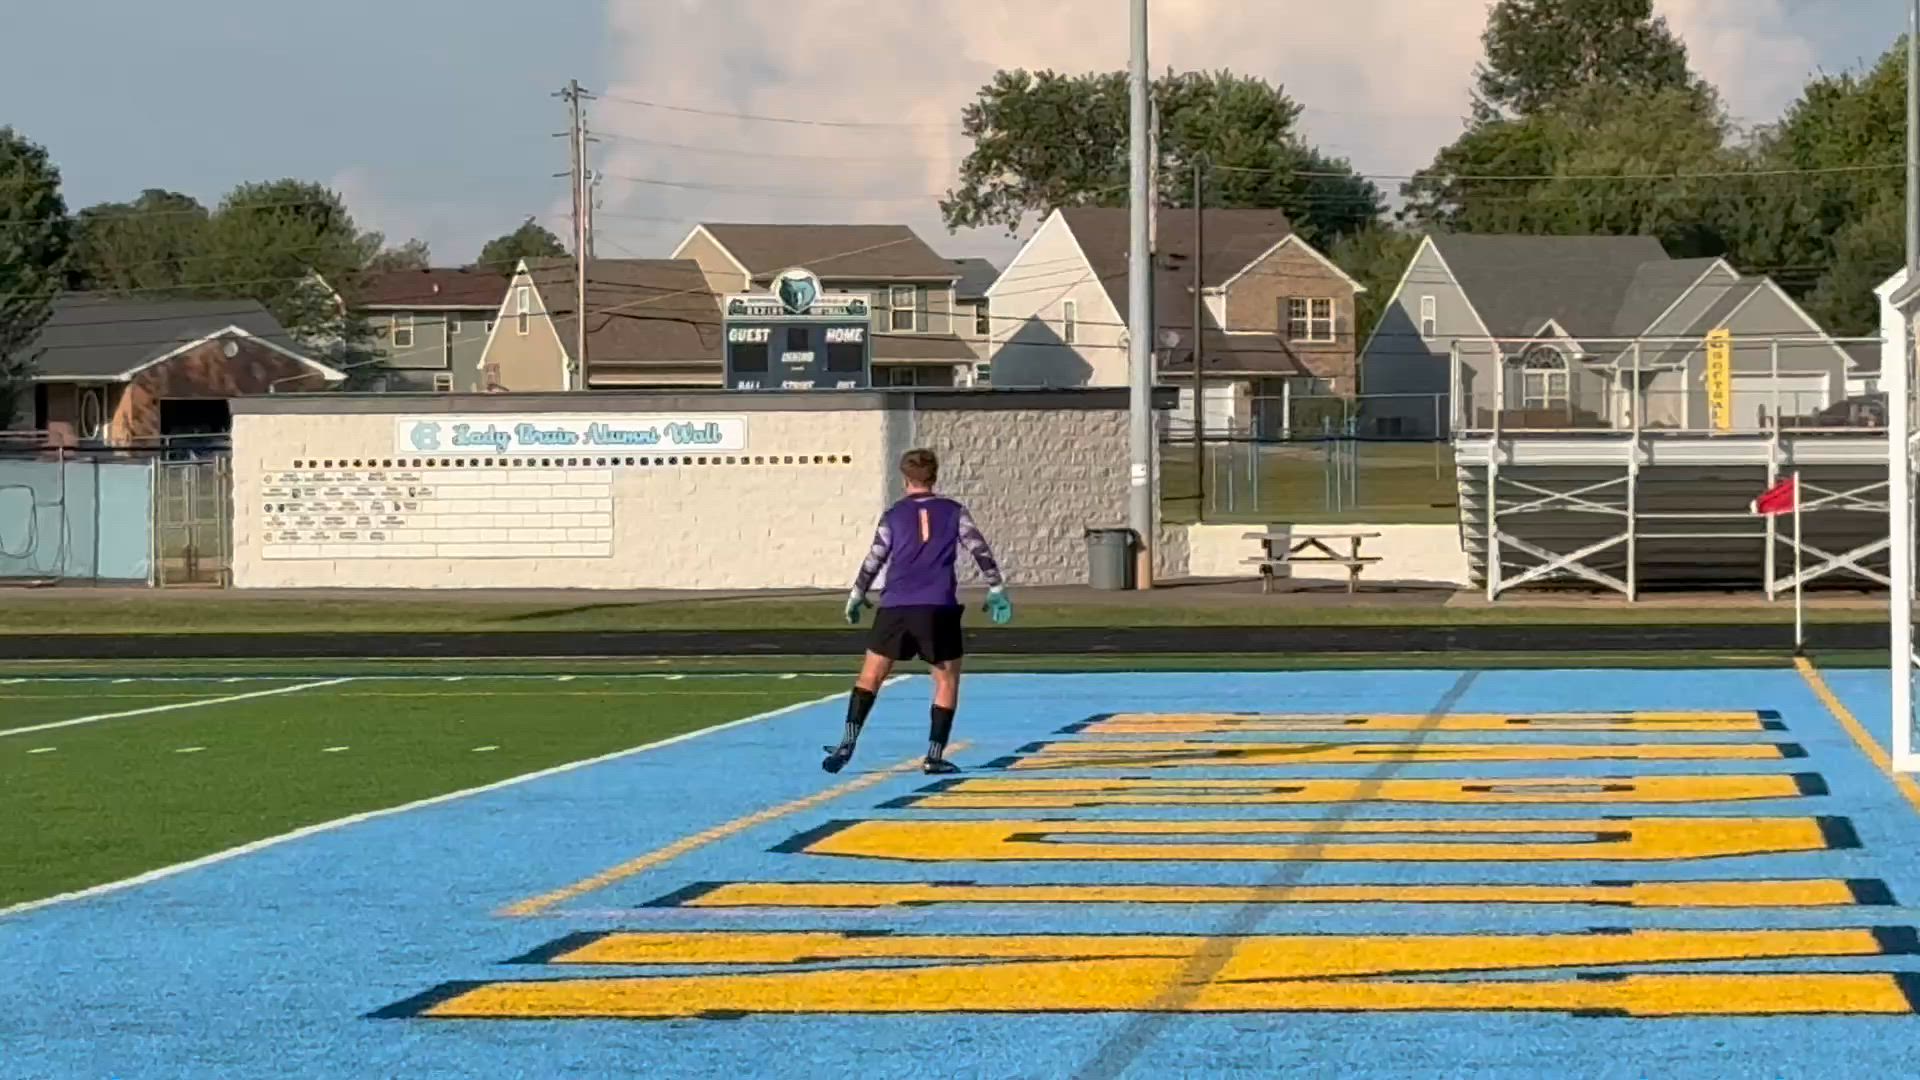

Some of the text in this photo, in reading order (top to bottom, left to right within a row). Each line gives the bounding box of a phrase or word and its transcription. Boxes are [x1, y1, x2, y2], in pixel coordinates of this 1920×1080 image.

[729, 328, 770, 342] GUEST
[826, 328, 864, 342] HOME
[452, 421, 723, 454] Lady Bruin Alumni Wall
[919, 508, 929, 541] 1
[366, 709, 1919, 1019] HARDIN
